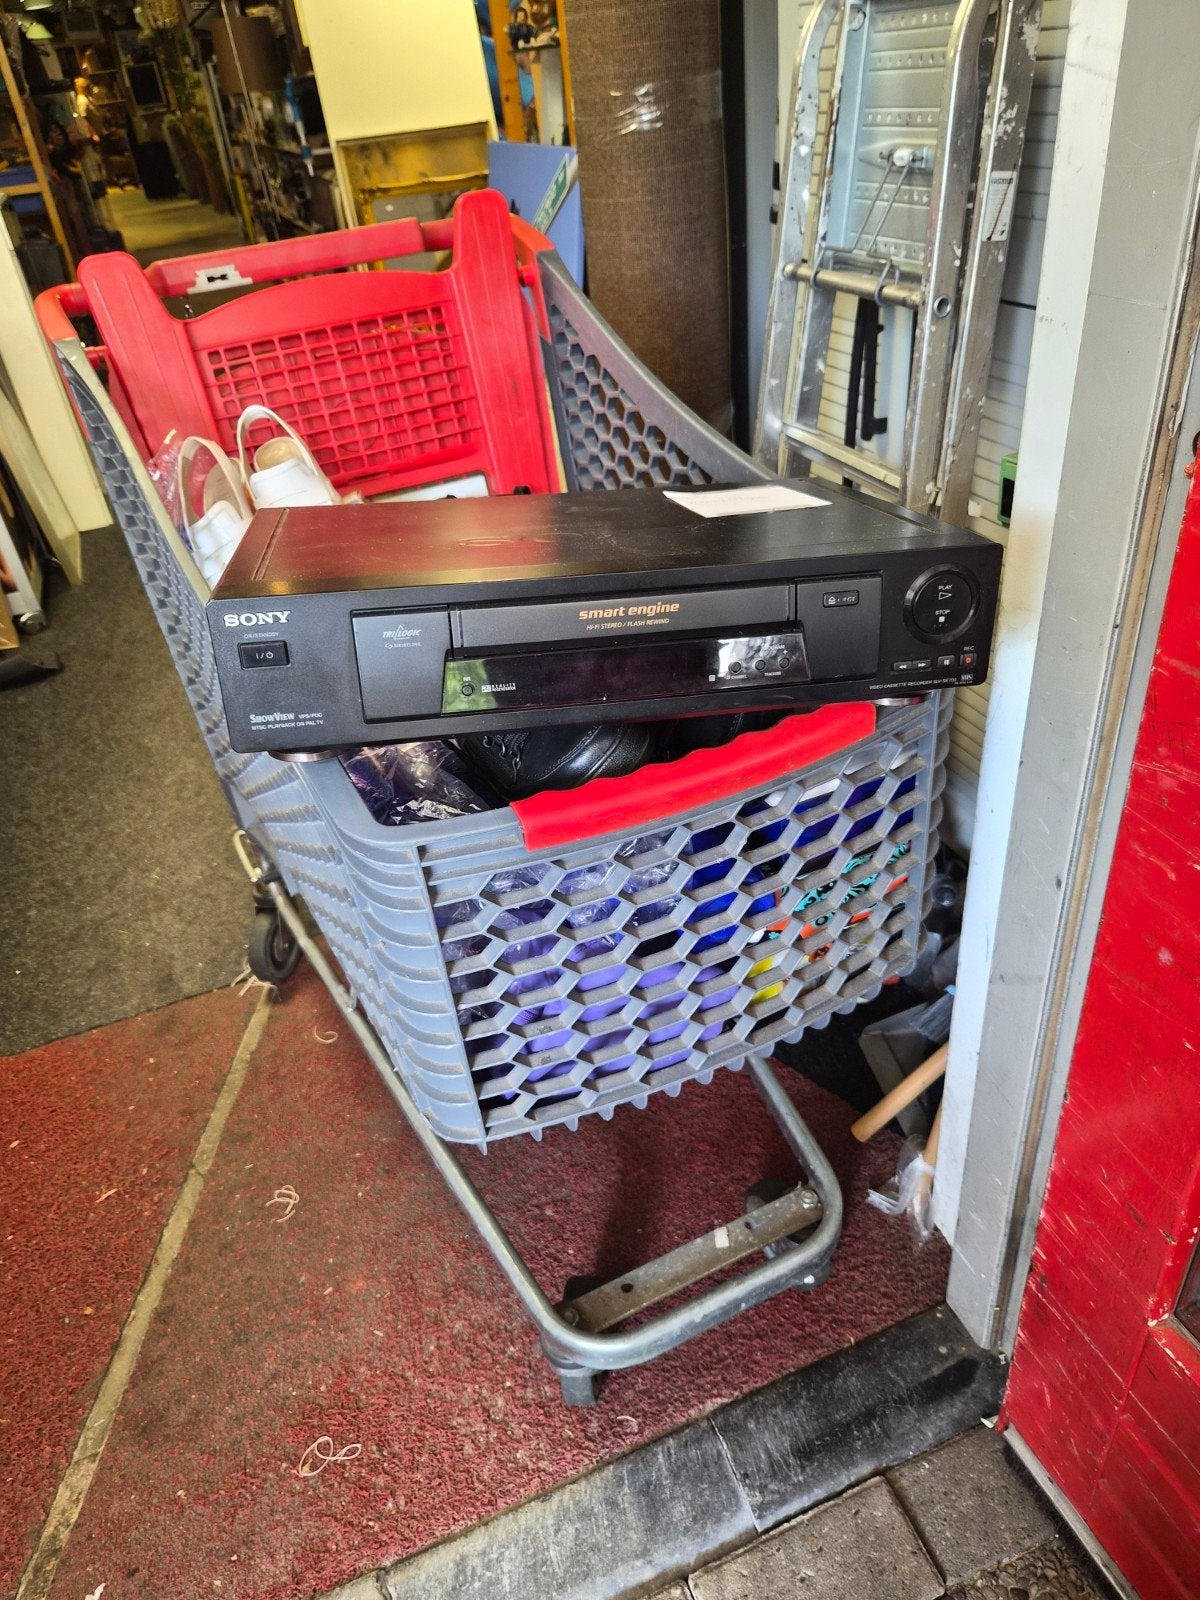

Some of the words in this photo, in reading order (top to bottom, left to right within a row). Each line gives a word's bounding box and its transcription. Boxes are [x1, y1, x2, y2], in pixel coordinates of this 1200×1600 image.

[579, 607, 626, 620] smart
[627, 602, 680, 617] engine
[223, 610, 292, 628] SONY
[586, 623, 601, 631] HI-FI
[600, 621, 623, 630] STEREO
[646, 618, 670, 626] REWIND
[907, 679, 933, 687] RECORDER
[267, 722, 296, 730] PLAYBACK
